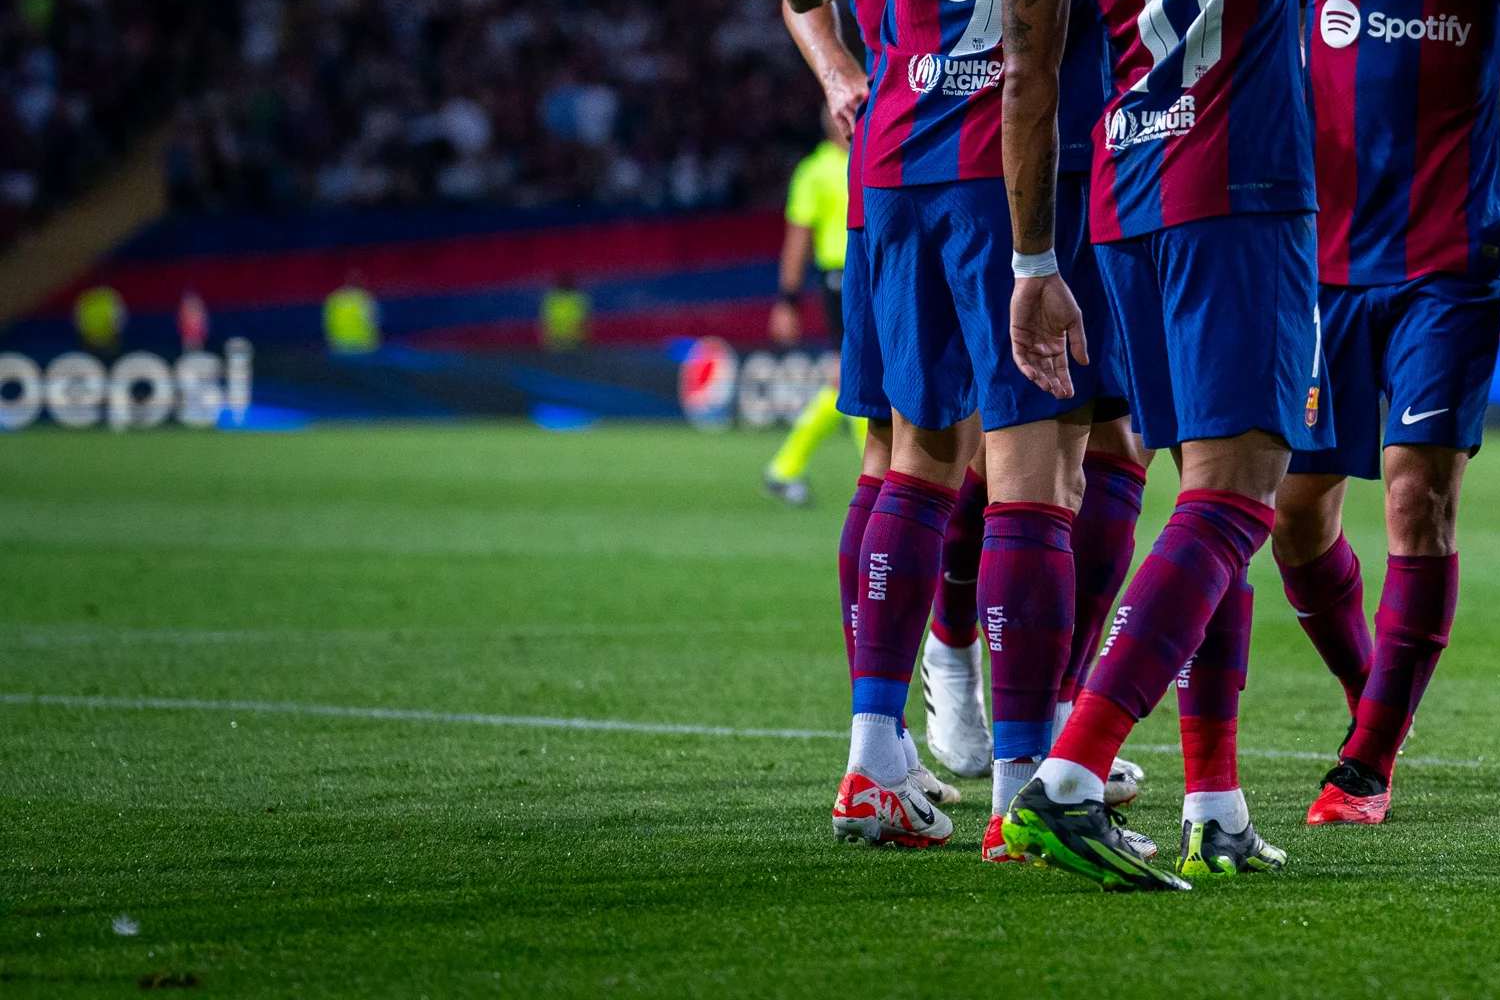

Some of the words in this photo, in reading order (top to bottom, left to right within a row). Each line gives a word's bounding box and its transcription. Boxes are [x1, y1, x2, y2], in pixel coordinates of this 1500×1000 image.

[1367, 12, 1472, 46] Spotify
[868, 553, 892, 600] BARÇA
[987, 605, 1008, 652] BARÇA
[1100, 605, 1132, 656] BARÇA
